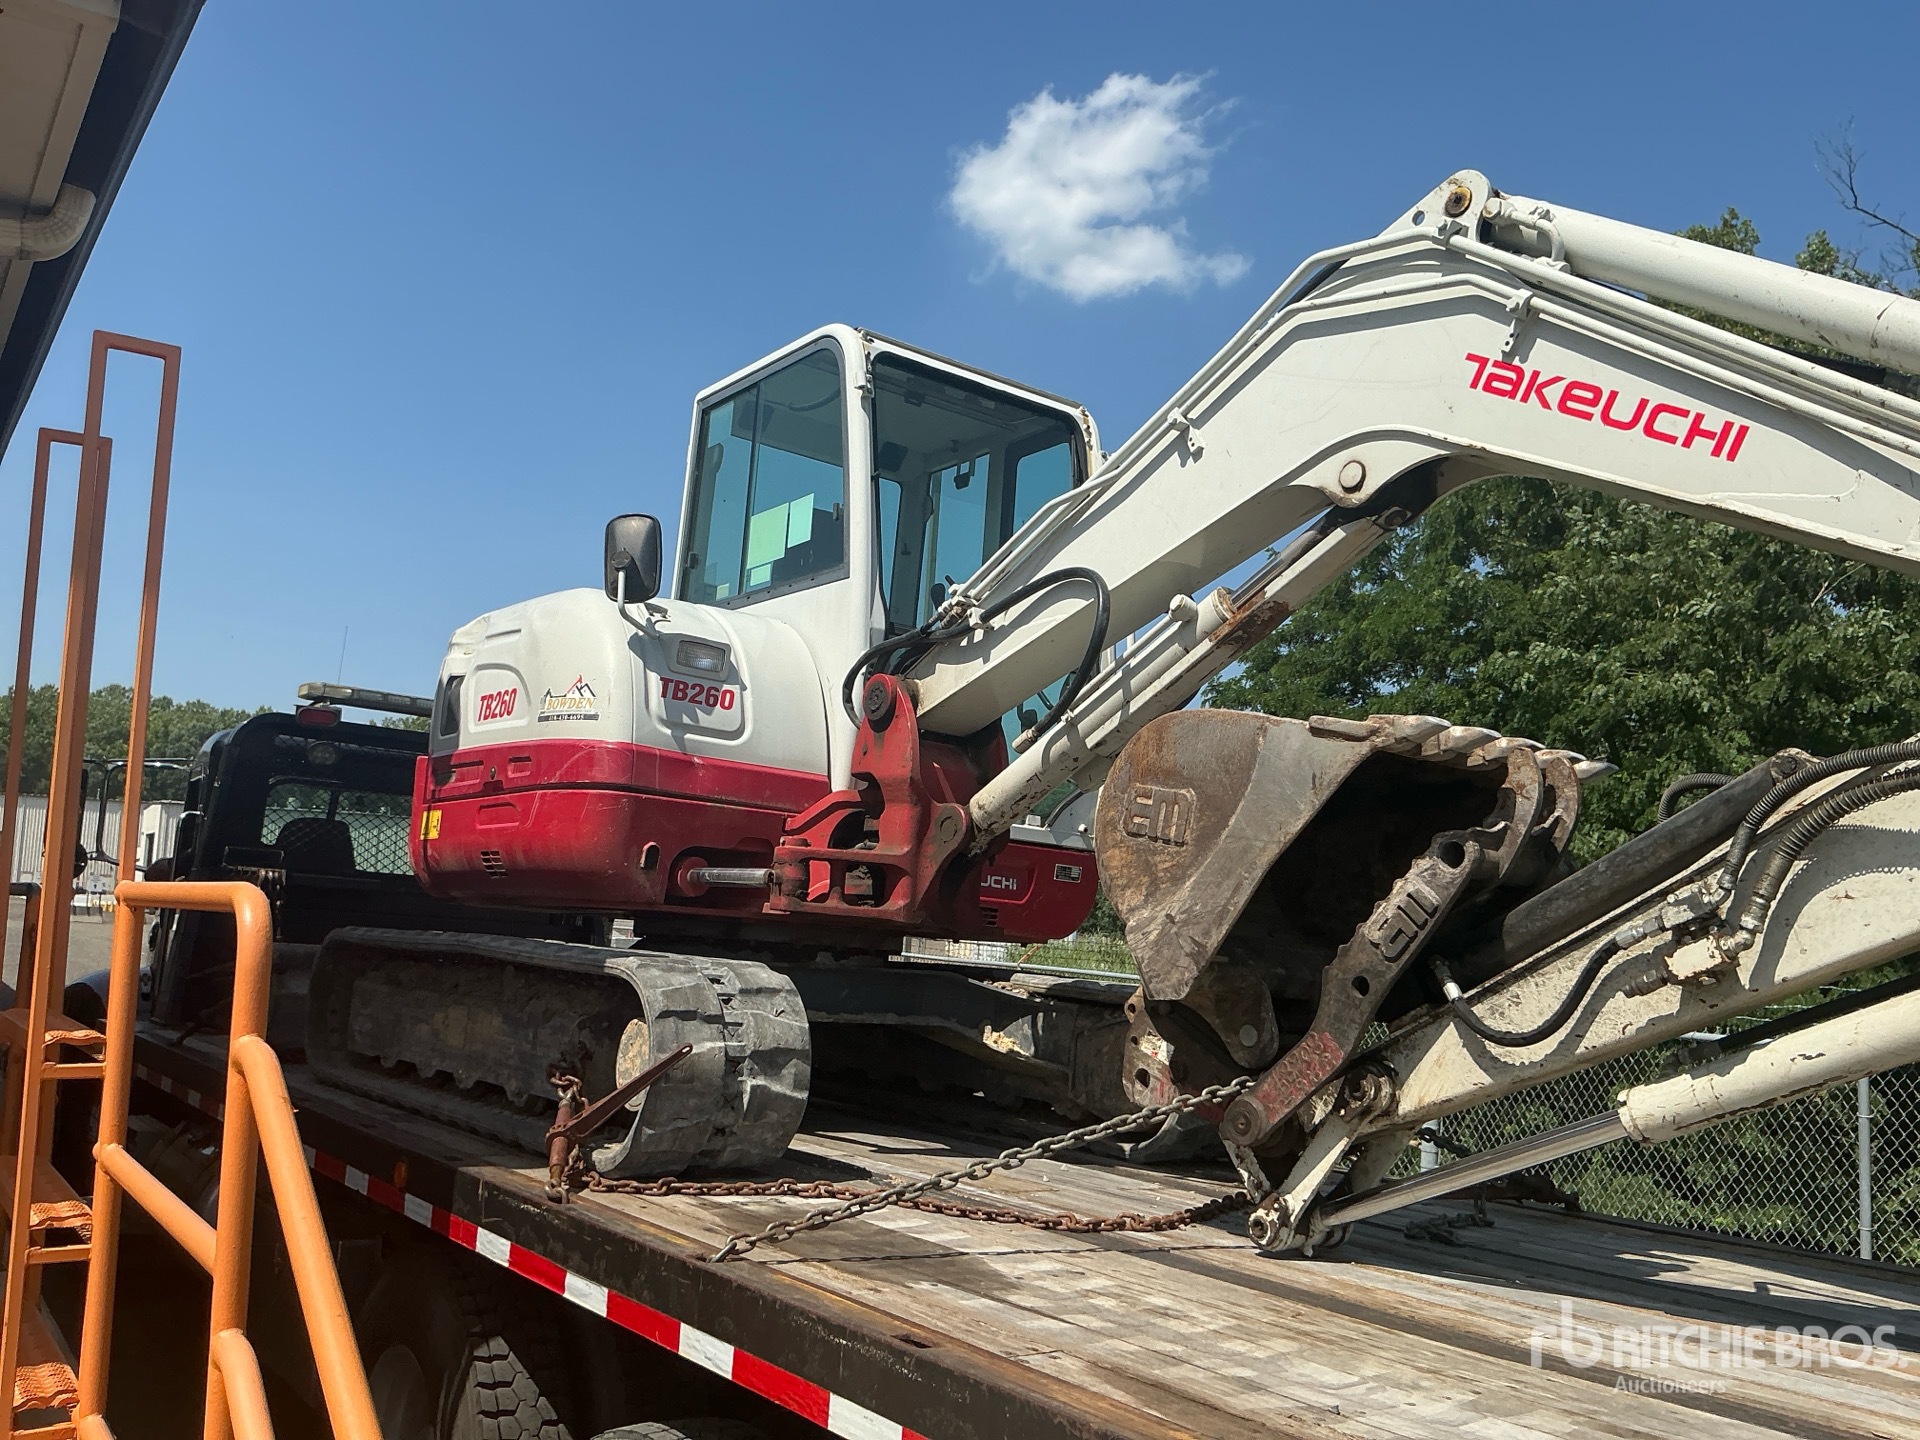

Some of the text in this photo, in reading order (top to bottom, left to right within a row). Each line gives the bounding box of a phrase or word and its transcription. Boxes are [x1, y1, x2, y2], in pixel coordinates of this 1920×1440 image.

[477, 687, 518, 722] TB260
[546, 697, 597, 711] BOWDEN
[660, 676, 735, 711] TB260
